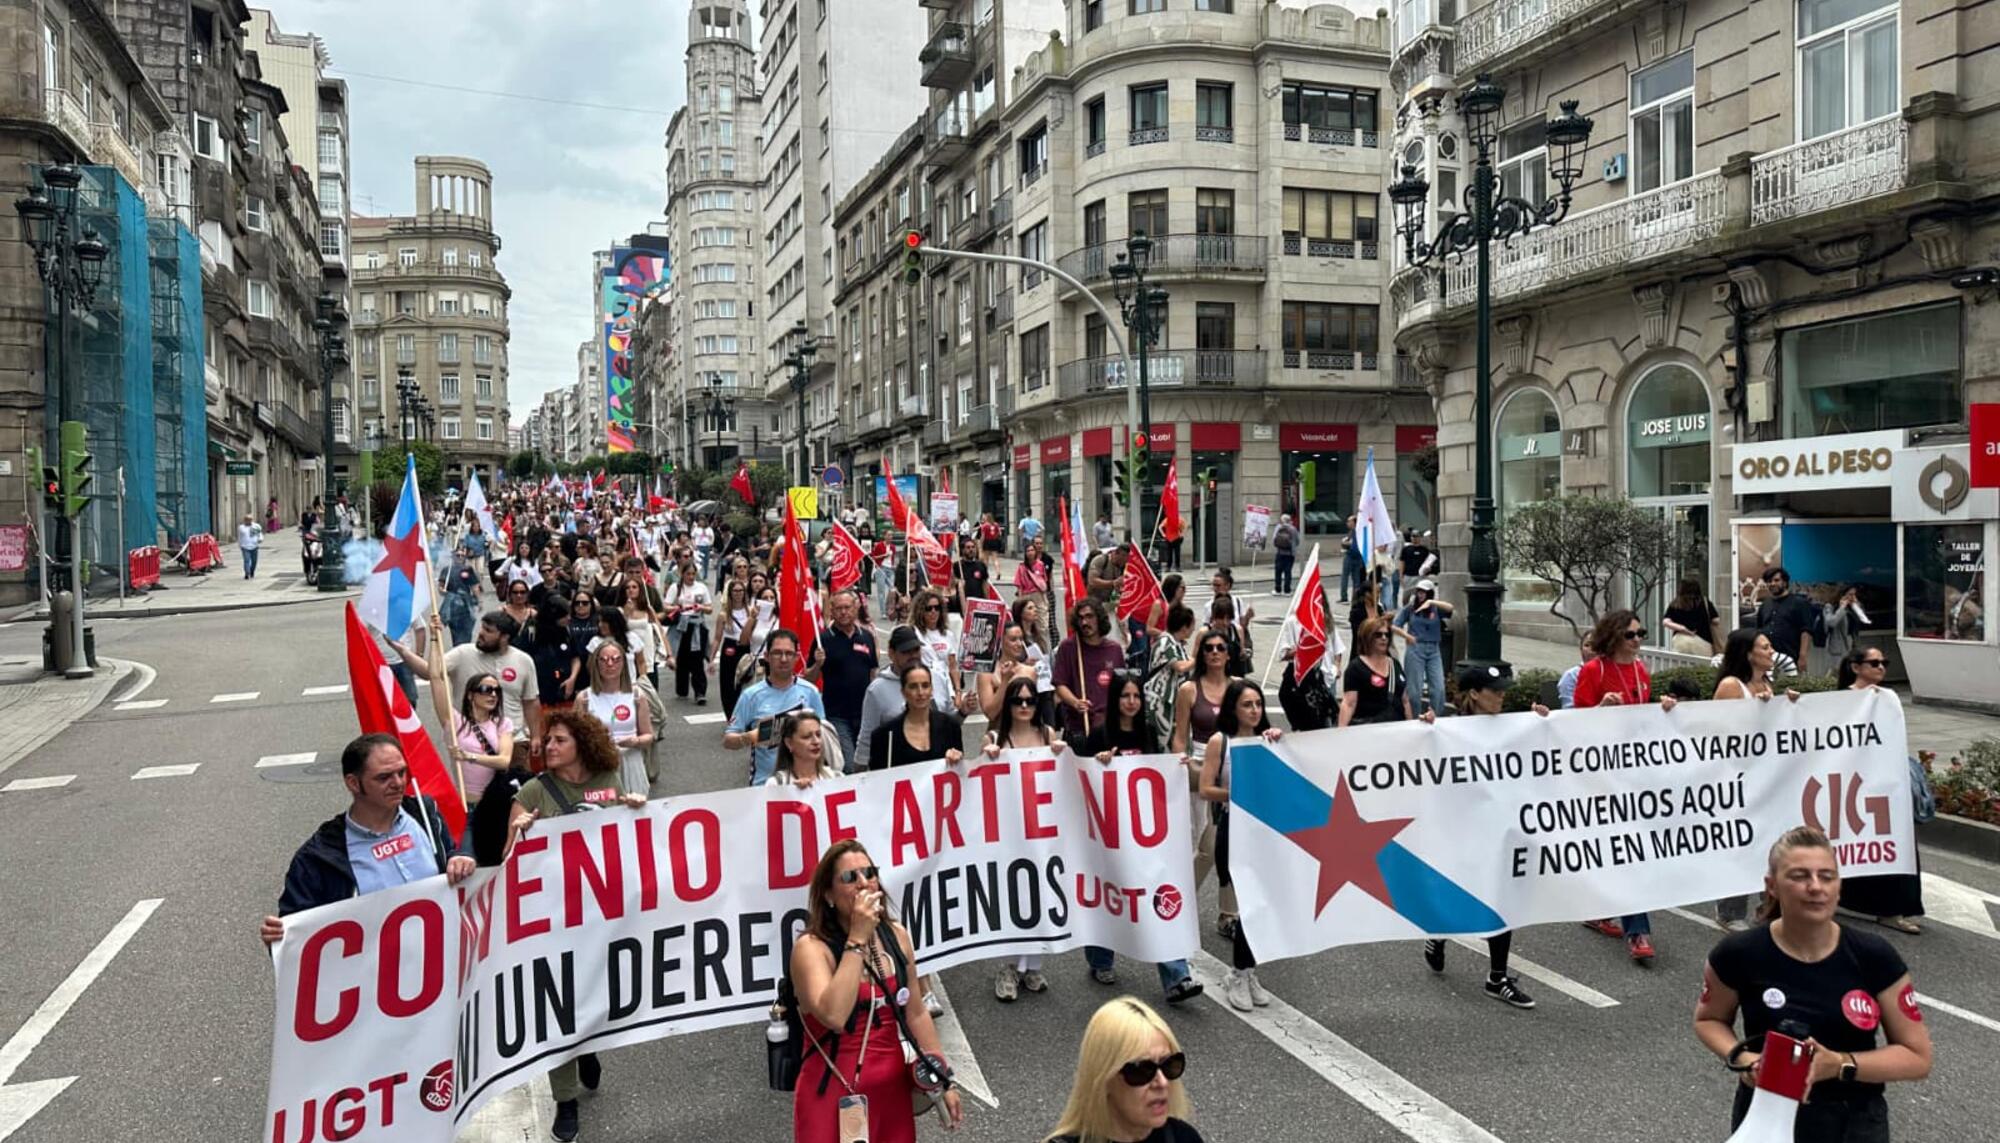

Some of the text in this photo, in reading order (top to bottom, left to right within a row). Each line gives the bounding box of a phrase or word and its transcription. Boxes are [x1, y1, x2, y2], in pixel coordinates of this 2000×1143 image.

[1641, 415, 1706, 436] JOSE LUIS
[1739, 447, 1893, 480] ORO AL PESO
[1951, 542, 1980, 551] TALLER
[1960, 552, 1971, 562] DE
[1348, 721, 1883, 792] CONVENIO DE COMERCIO VARIO EN LOITA
[584, 789, 605, 801] UGT
[890, 759, 1059, 868] ARTE
[1078, 766, 1169, 850] NO
[1519, 772, 1746, 835] CONVENIOS AQUÍ
[372, 841, 400, 860] UGT
[1512, 818, 1754, 878] E NON EN MADRID
[1833, 841, 1897, 867] VIZOS
[1075, 872, 1147, 924] UGT
[494, 950, 576, 1059] UN
[901, 855, 1069, 951] MENOS
[271, 1071, 409, 1143] UGT
